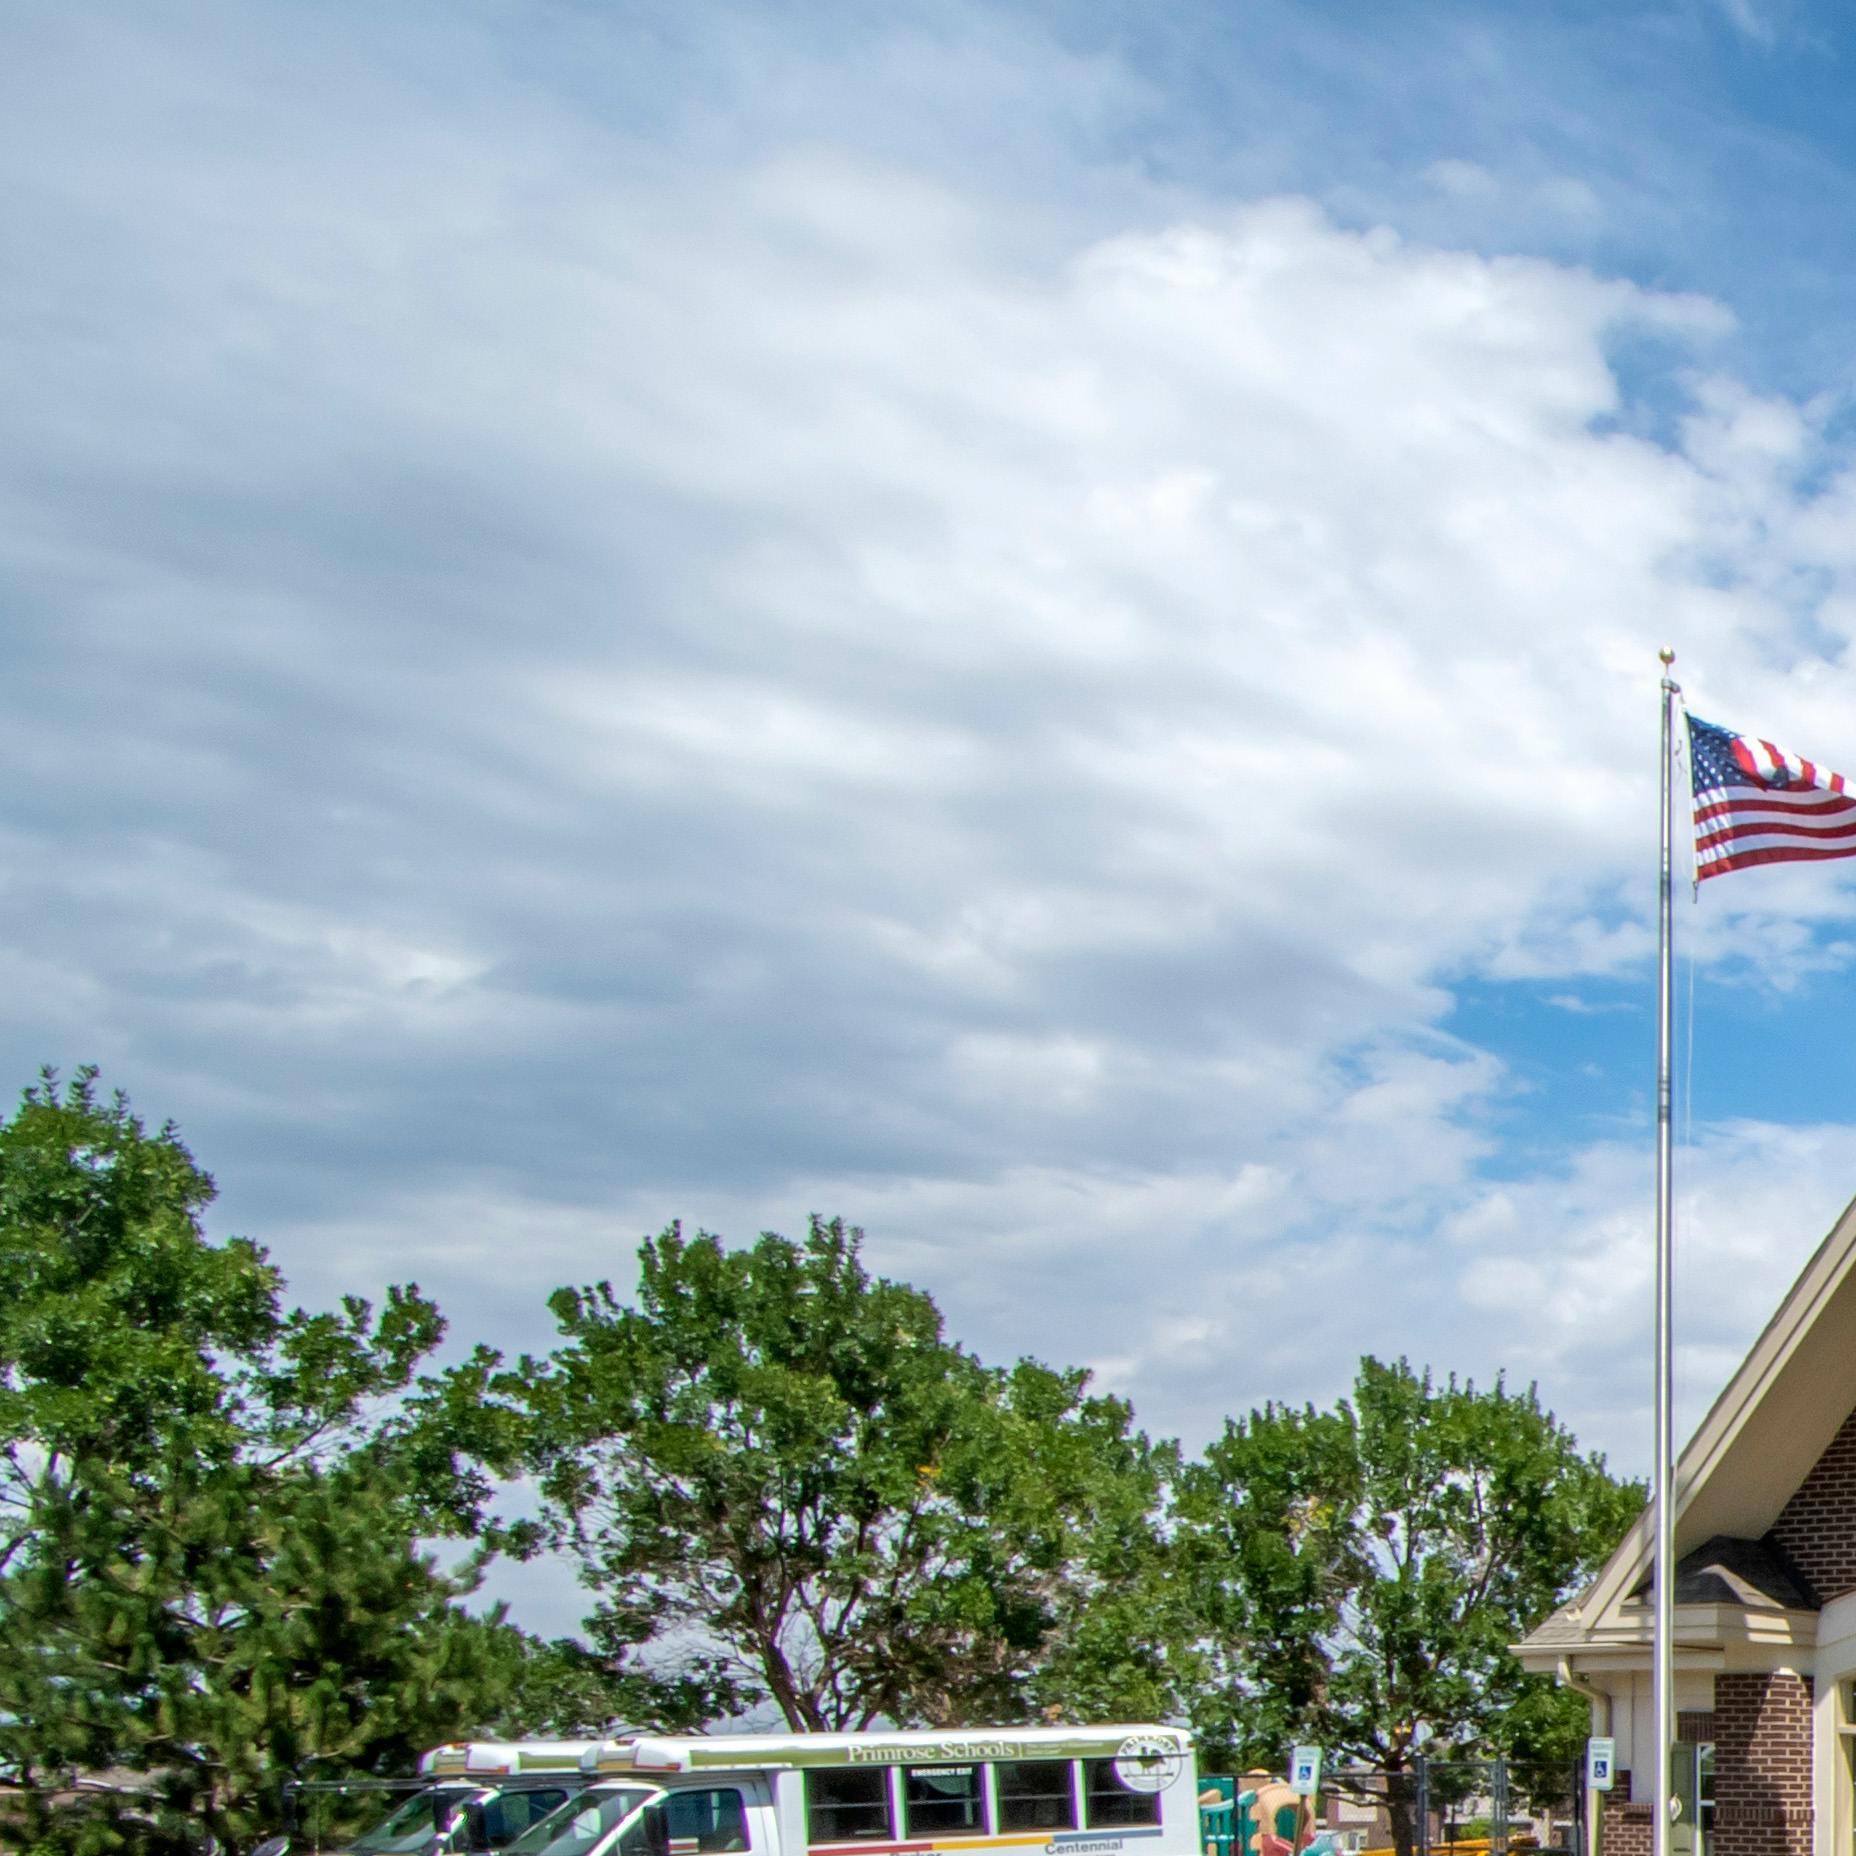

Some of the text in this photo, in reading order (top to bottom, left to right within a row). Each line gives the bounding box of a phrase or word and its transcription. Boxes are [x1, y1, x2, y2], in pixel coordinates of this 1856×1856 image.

[848, 1744, 935, 1762] Primrose
[940, 1741, 1014, 1759] Schools
[1045, 1840, 1123, 1855] Centennial
